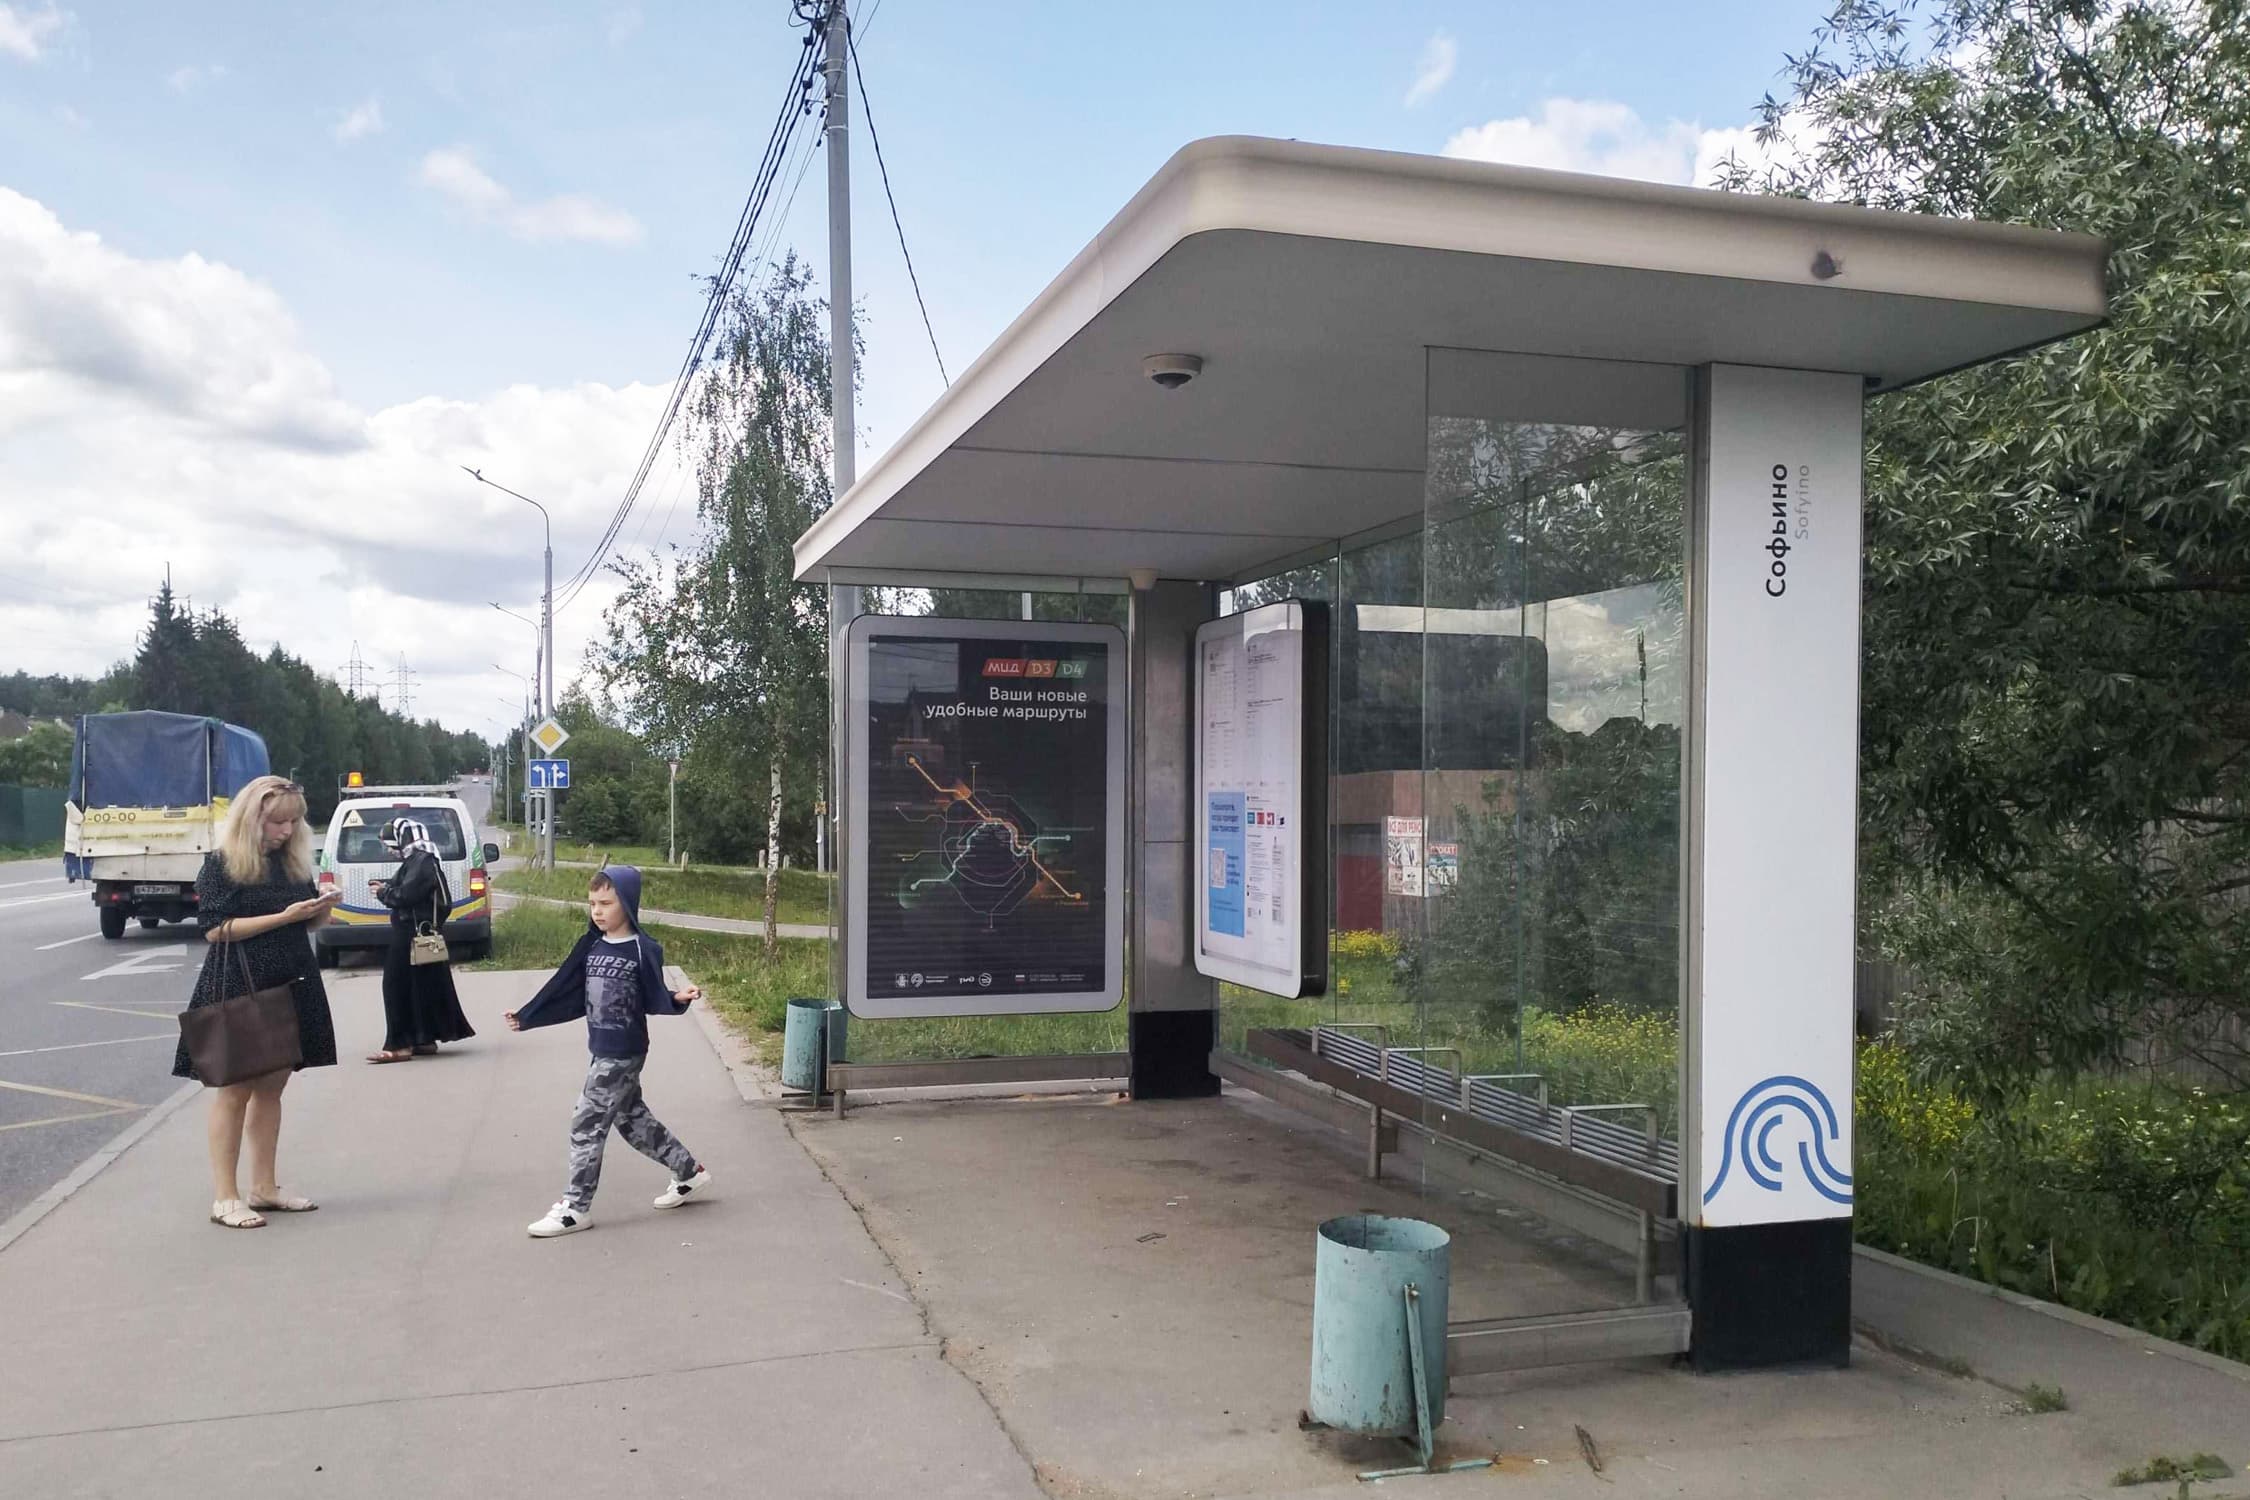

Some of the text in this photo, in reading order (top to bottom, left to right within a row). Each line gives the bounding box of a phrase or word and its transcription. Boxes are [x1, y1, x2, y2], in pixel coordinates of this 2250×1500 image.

[1795, 465, 1812, 540] Sofyino
[1765, 464, 1791, 597] Софьино
[1062, 663, 1083, 676] D4
[989, 687, 1088, 703] Ваши новые
[925, 703, 1087, 722] удобные маршруты
[586, 955, 638, 971] SUPER
